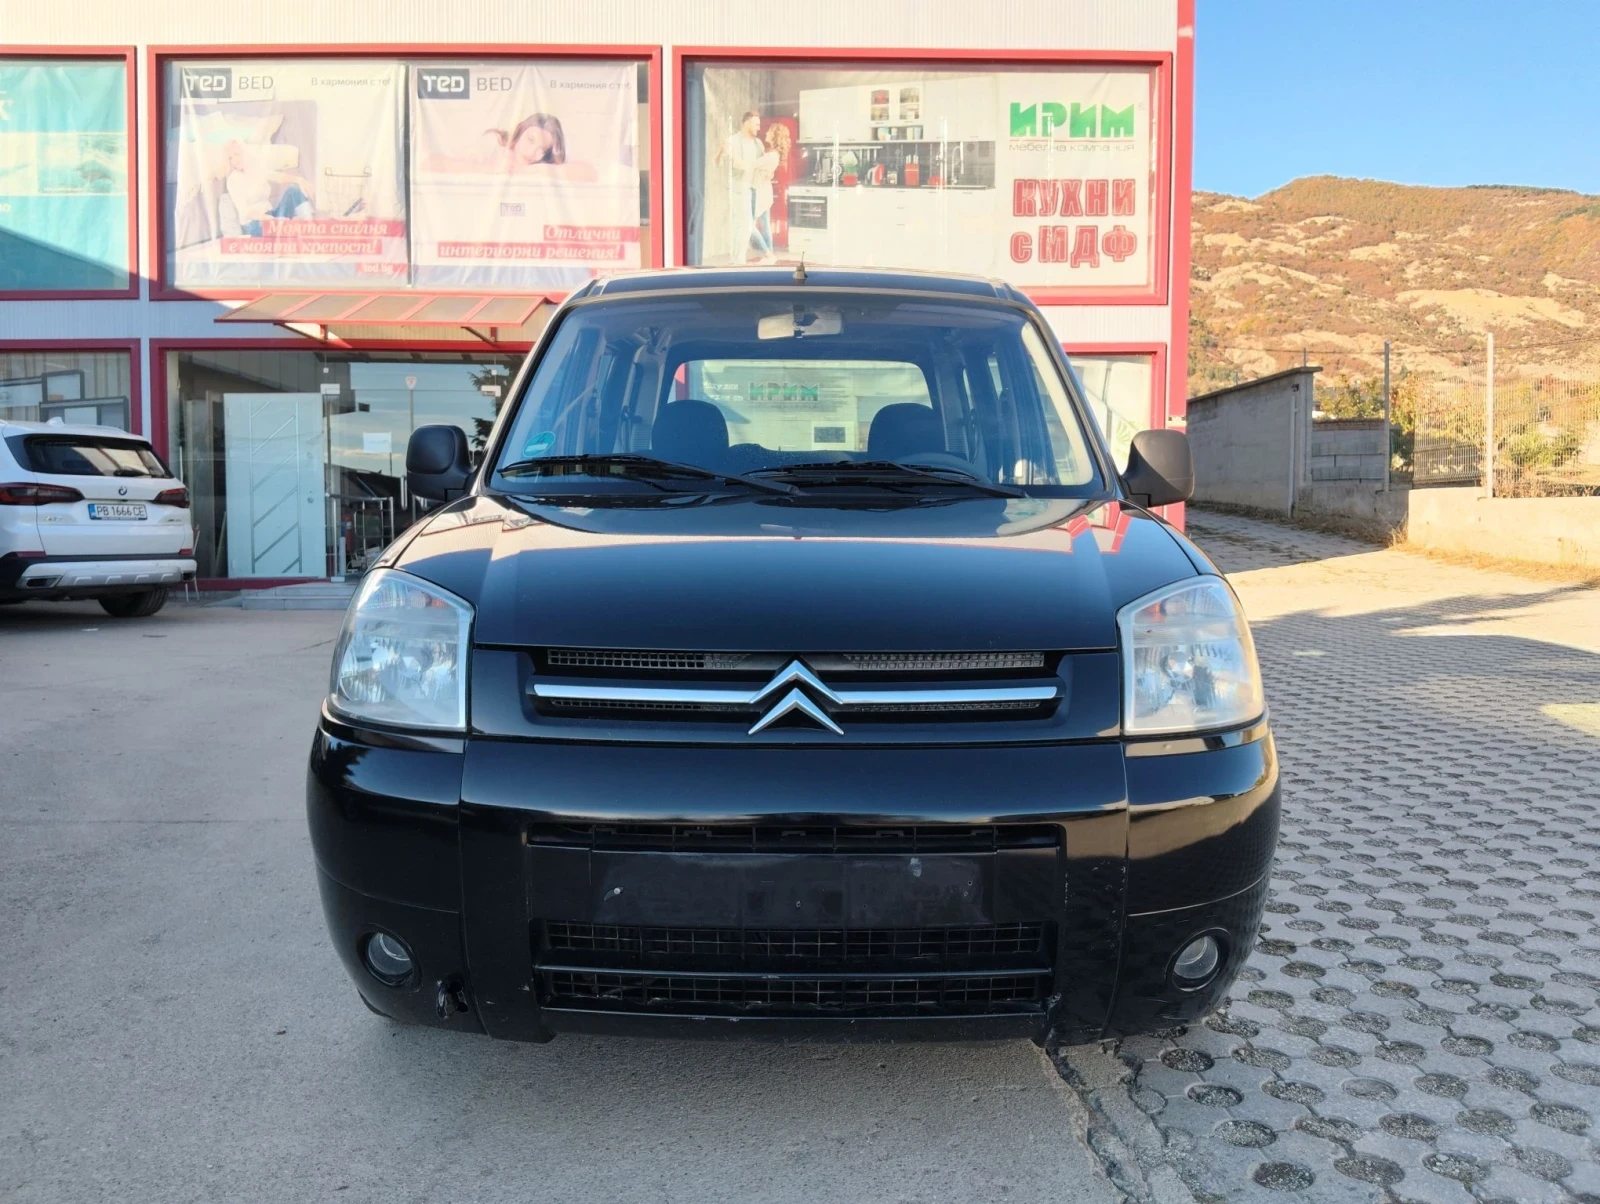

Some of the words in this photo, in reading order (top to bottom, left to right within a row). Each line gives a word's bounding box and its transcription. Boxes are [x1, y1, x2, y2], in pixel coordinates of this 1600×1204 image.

[239, 76, 274, 90] BED
[320, 78, 368, 88] хармония
[477, 77, 513, 91] BED
[559, 81, 607, 91] хармония
[1010, 102, 1135, 138] ИРИМ
[1013, 178, 1136, 217] КУХНИ
[267, 220, 327, 235] Моята
[331, 221, 388, 235] спалня
[545, 225, 621, 240] Отлични
[242, 242, 297, 253] моята
[302, 239, 378, 255] крепост!
[440, 244, 541, 259] интериорни
[546, 244, 620, 260] решения!
[1010, 231, 1033, 263] с
[1038, 225, 1137, 268] МДФ
[748, 381, 819, 402] ИРИМ
[96, 506, 109, 516] PB
[111, 506, 132, 516] 1666
